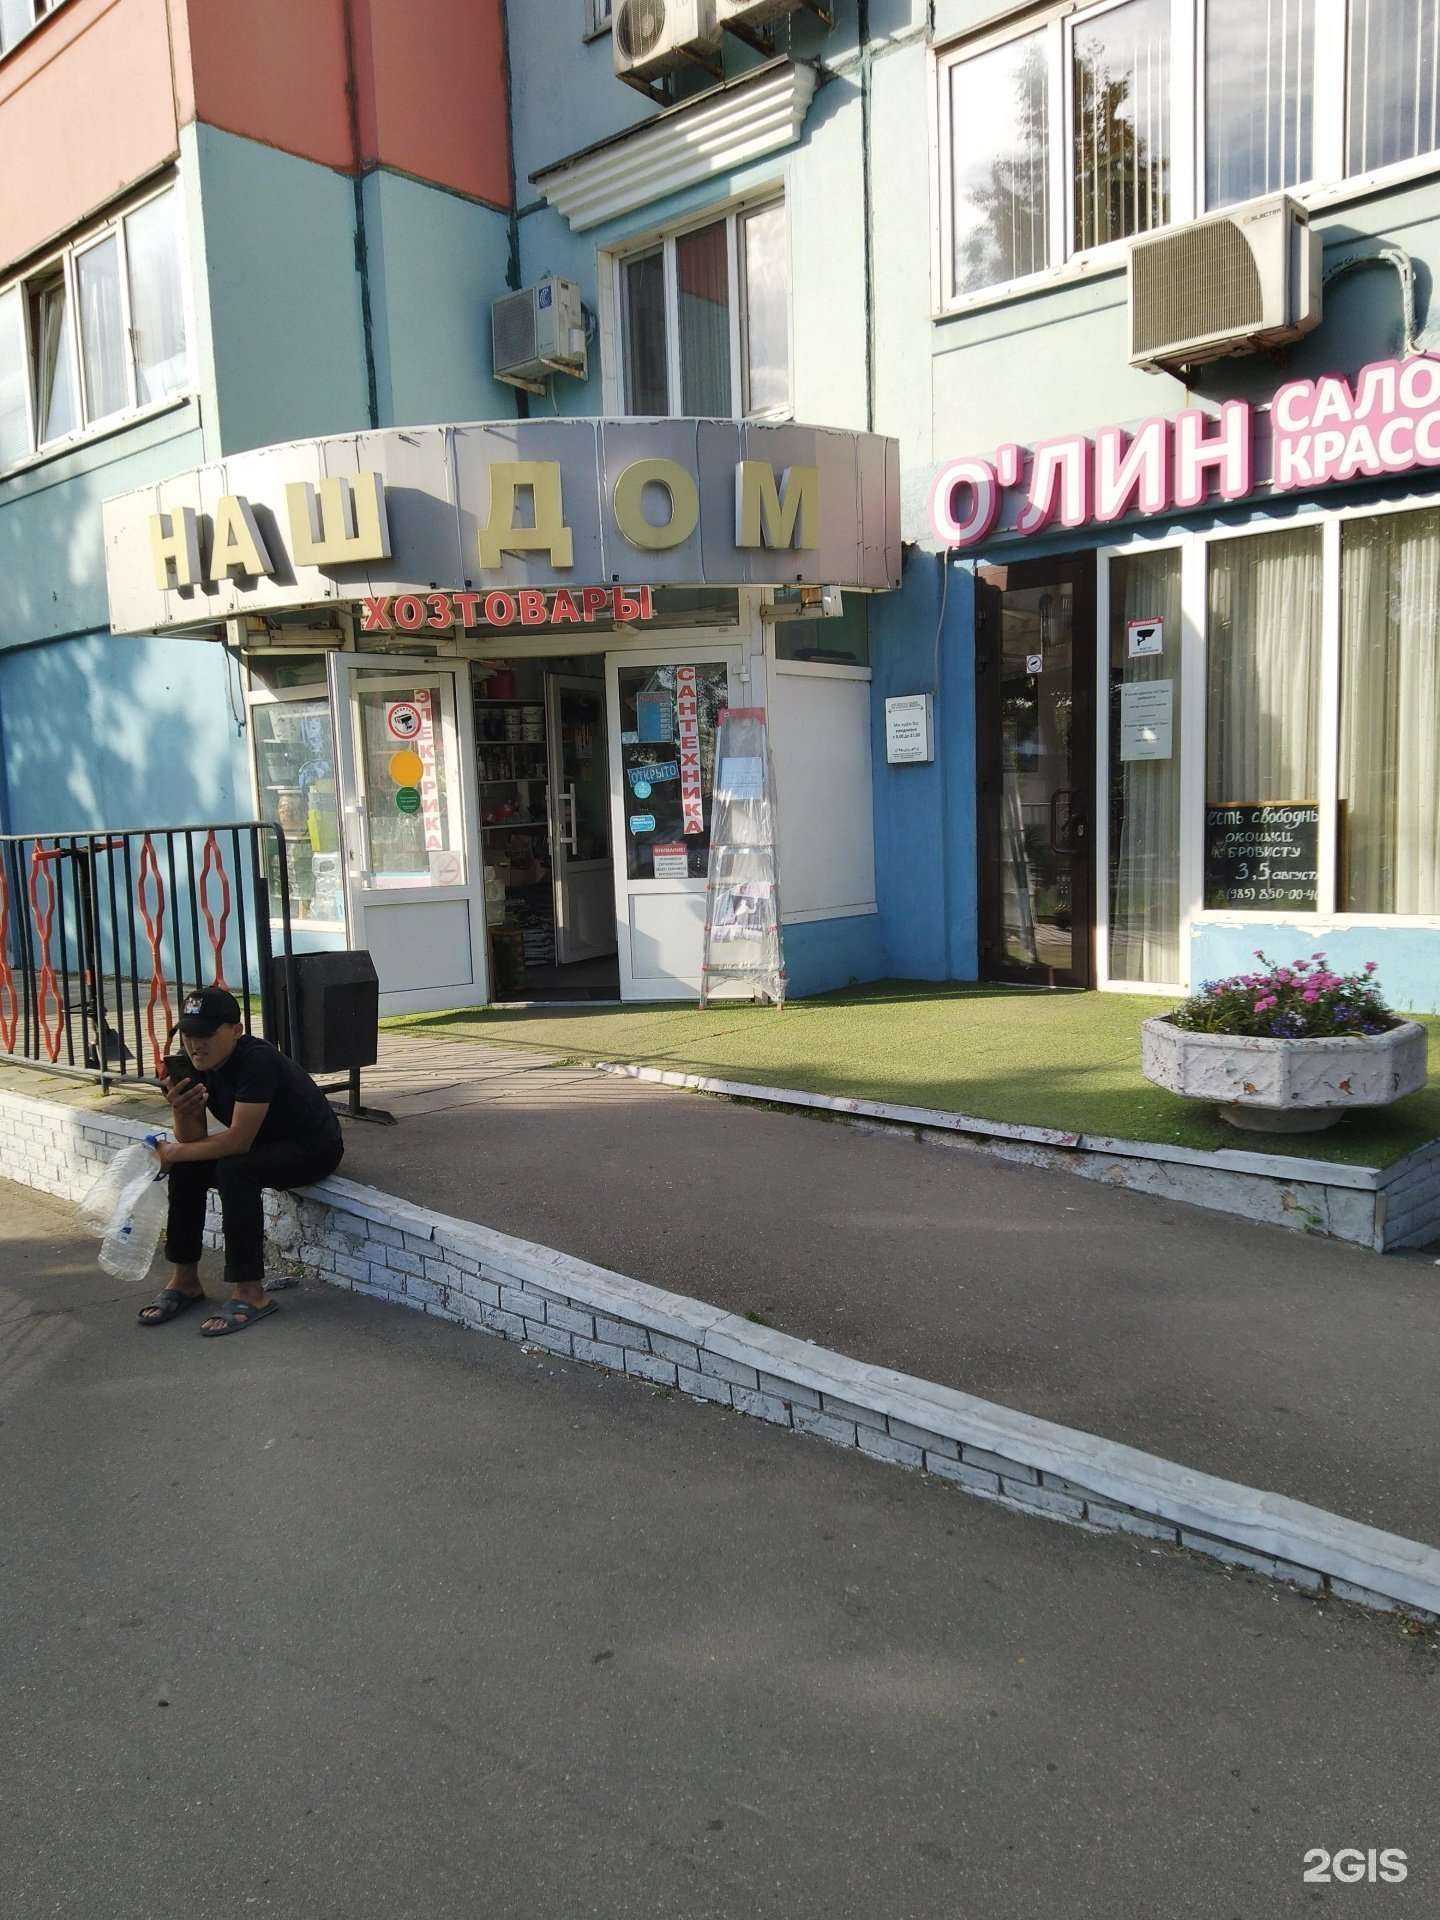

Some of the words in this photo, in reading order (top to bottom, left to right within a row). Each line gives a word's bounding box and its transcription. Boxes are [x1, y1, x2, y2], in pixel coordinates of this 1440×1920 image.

[149, 472, 391, 590] НАШ
[478, 458, 819, 569] ДОМ
[930, 402, 1253, 546] О'ЛИН
[362, 585, 653, 631] ХОЗТОВАРЫ
[631, 765, 676, 783] ОТКРЫТО
[677, 667, 703, 833] САНТЕХНИКА
